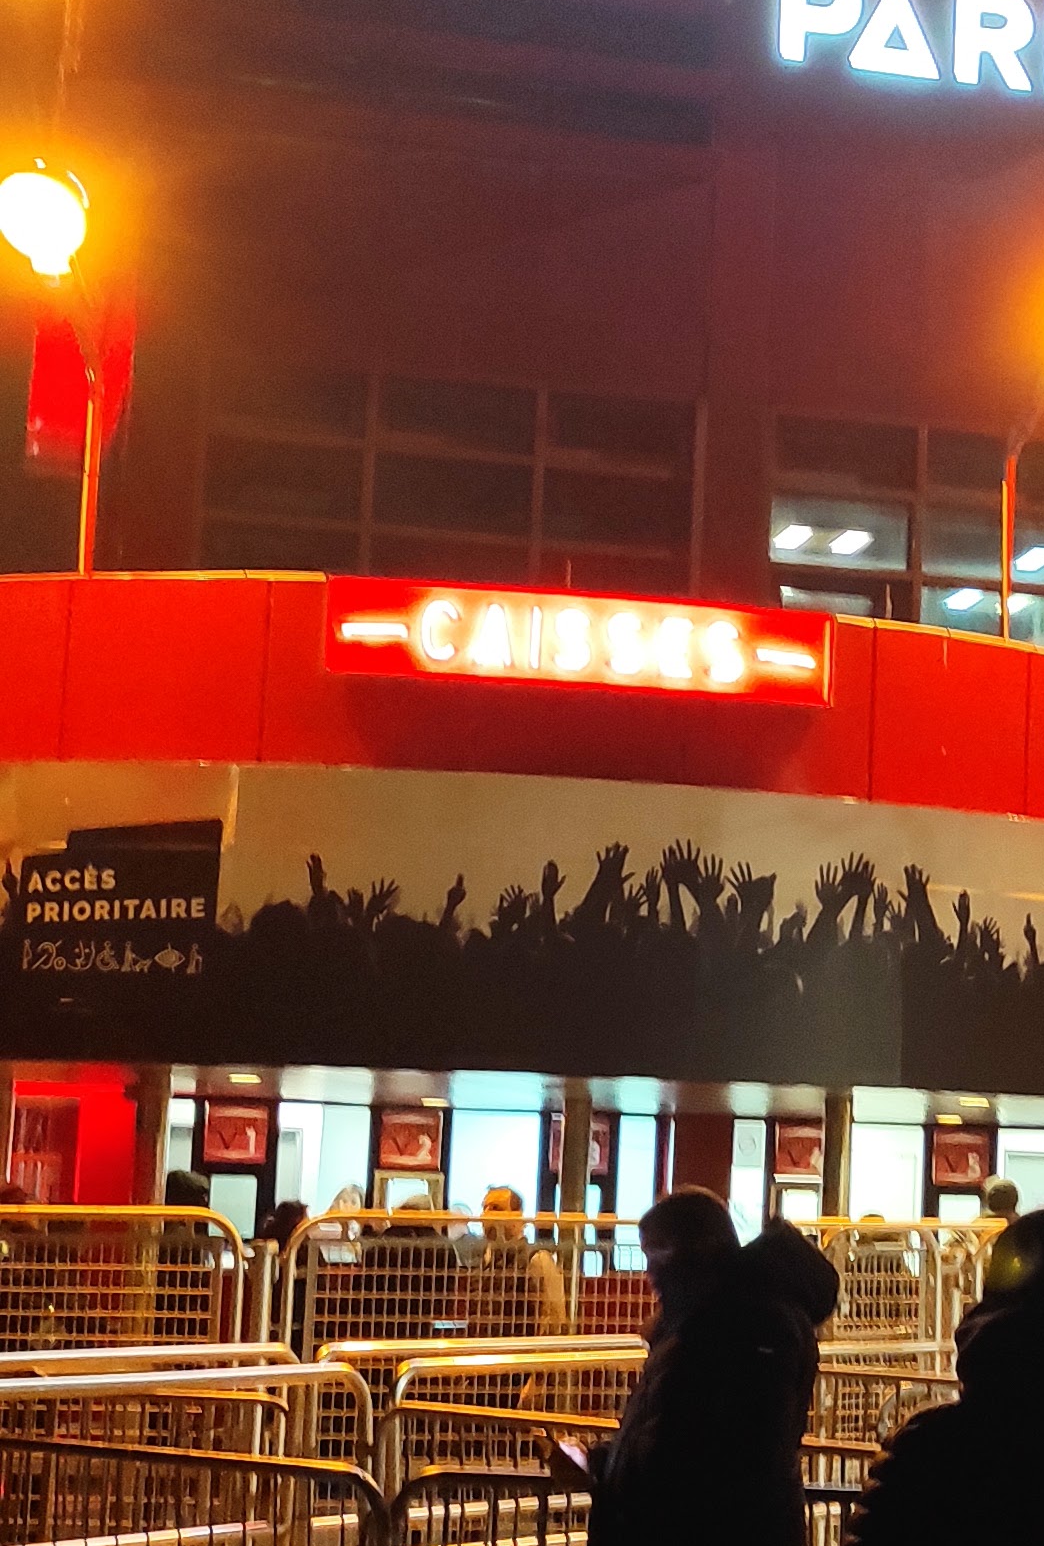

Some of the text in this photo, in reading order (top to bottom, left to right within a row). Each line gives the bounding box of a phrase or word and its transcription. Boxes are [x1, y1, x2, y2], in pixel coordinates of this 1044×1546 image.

[420, 599, 745, 683] CAISSES
[28, 862, 117, 894] ACCÈS
[26, 897, 206, 924] PRIORITAIRE
